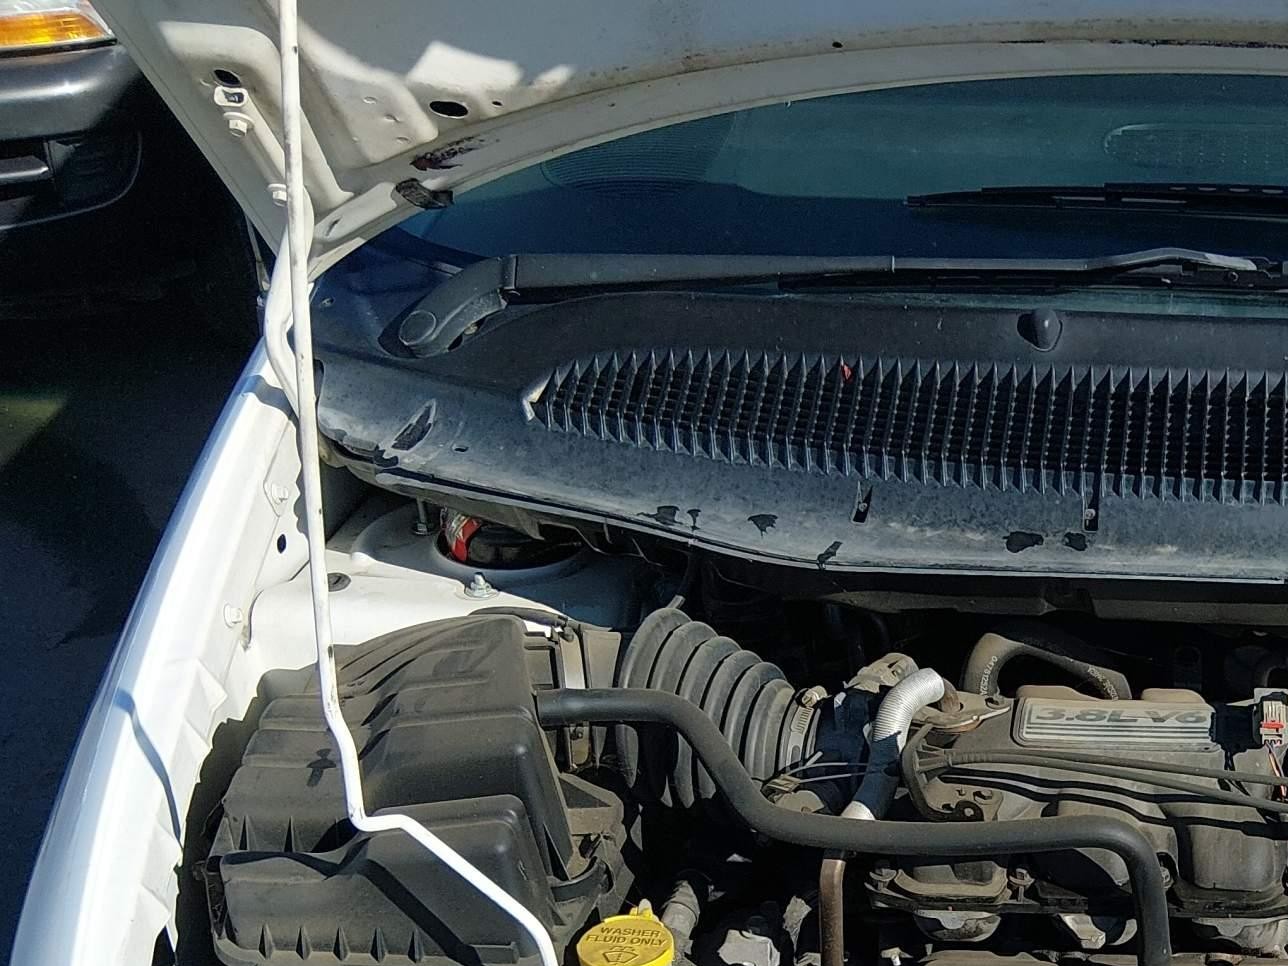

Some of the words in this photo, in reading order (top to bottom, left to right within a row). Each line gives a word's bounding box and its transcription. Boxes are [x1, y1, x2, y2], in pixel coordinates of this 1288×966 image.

[1035, 708, 1137, 723] 3.8L
[1145, 710, 1208, 724] V6
[600, 927, 661, 938] WASHER
[586, 935, 629, 945] FLUID
[630, 937, 667, 946] ONLY
